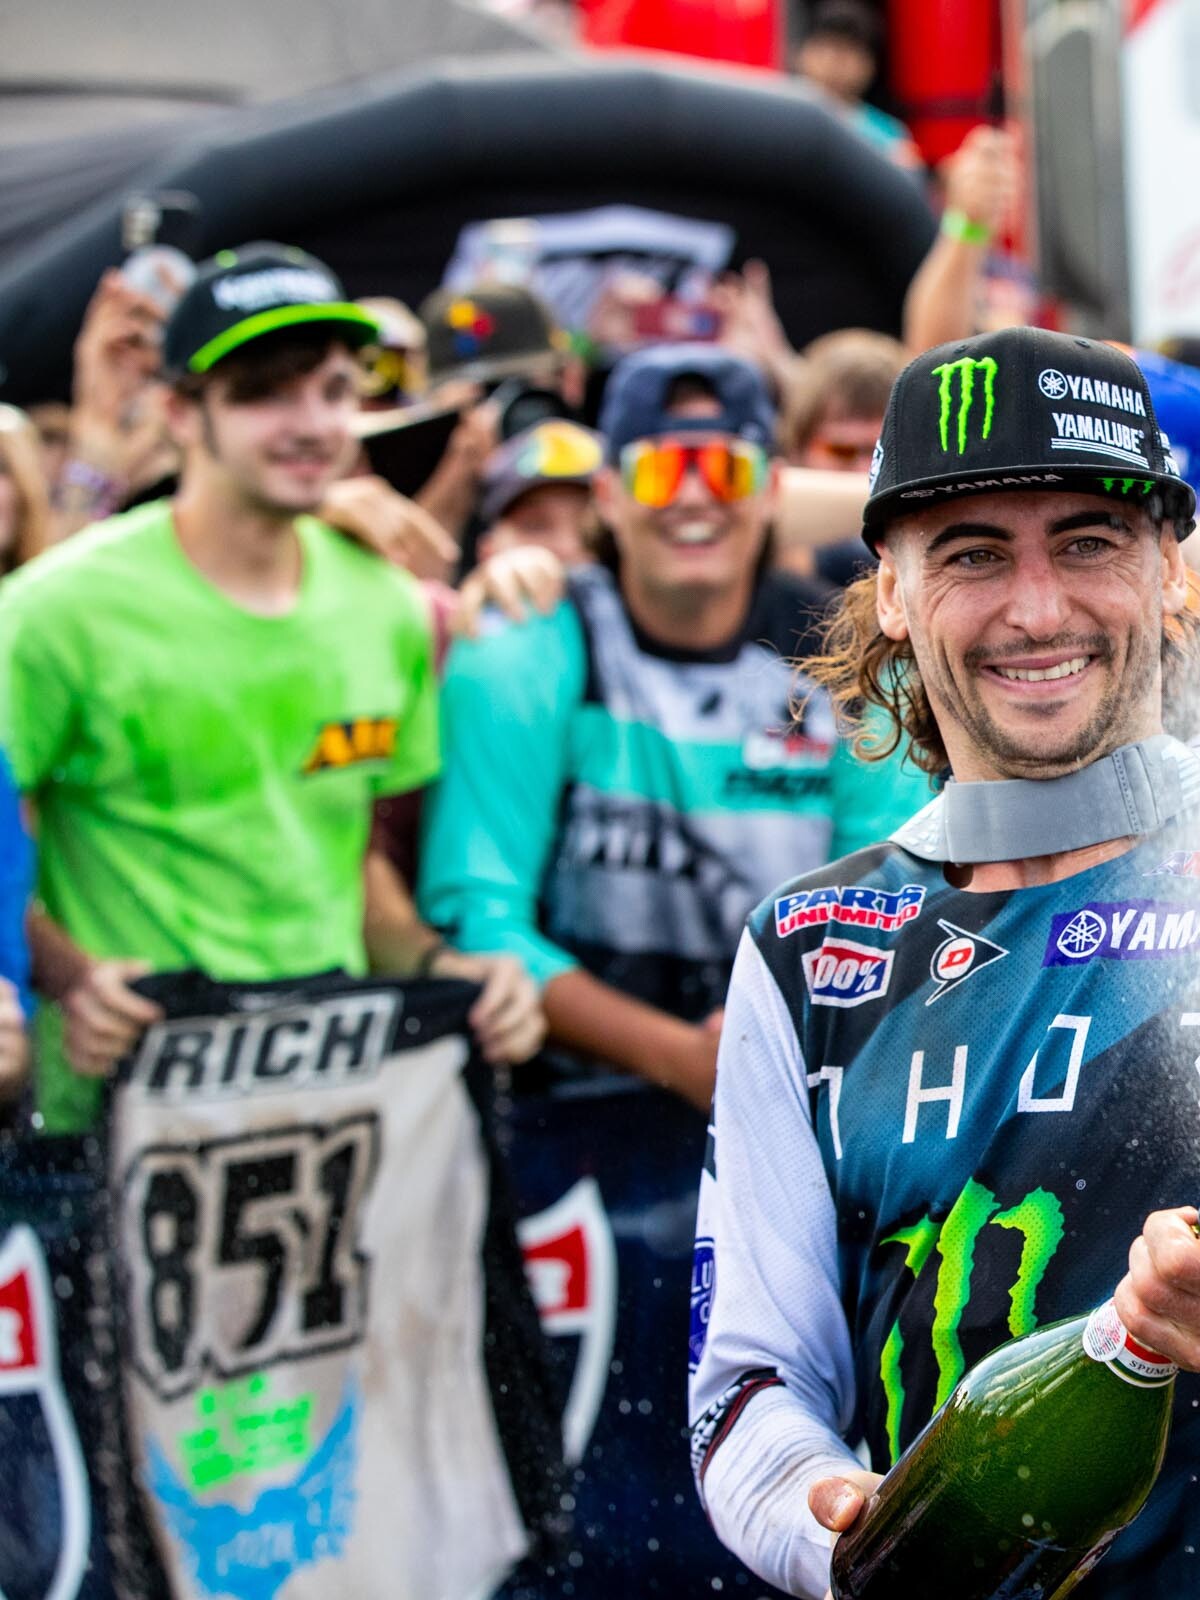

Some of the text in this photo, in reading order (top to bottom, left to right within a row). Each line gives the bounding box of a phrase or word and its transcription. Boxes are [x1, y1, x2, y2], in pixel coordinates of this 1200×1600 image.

[1067, 375, 1146, 417] YAMAHA
[934, 473, 1064, 495] YAMAHA
[779, 886, 922, 920] PARTS
[148, 1005, 376, 1091] RICH
[133, 1127, 372, 1390] 851
